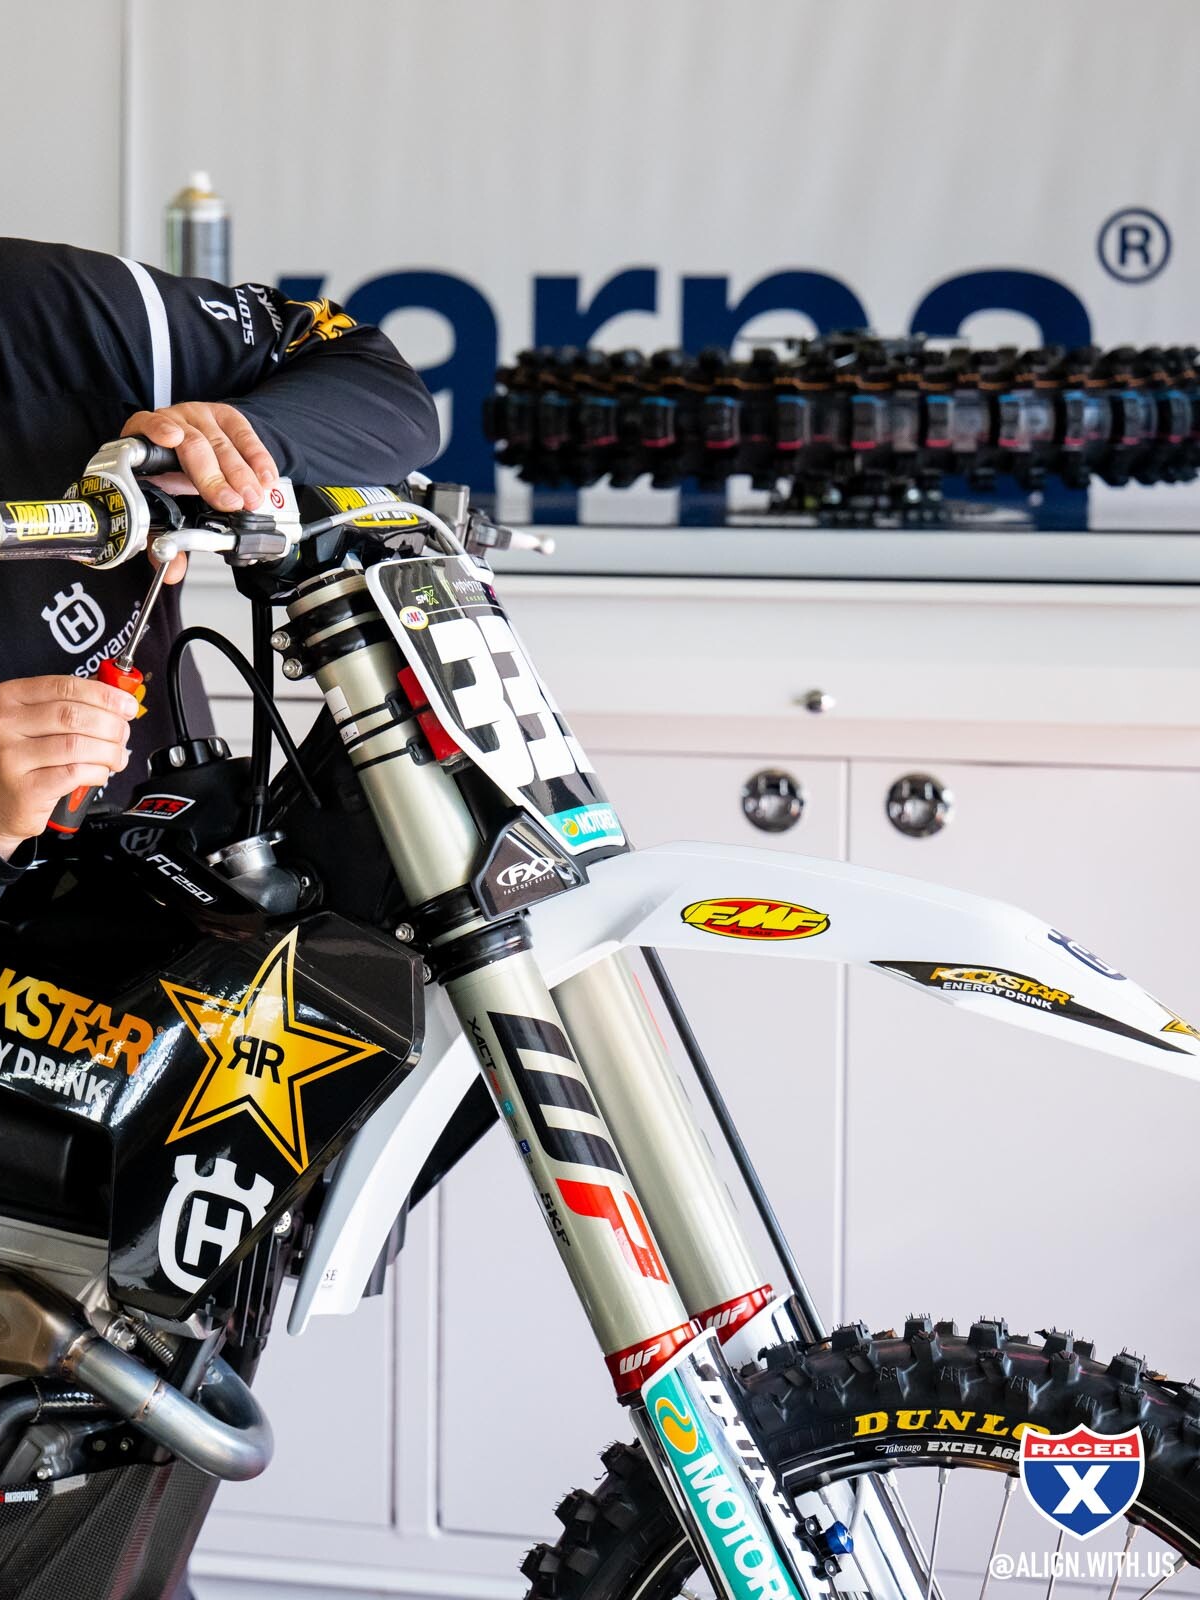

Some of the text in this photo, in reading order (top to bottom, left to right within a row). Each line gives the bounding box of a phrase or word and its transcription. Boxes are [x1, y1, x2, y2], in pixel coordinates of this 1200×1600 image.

[15, 503, 95, 536] PROTAPER
[682, 903, 830, 932] FMF
[930, 966, 1074, 1006] ROCKSTAR
[942, 981, 1053, 1011] ENERGY DRINK
[12, 1046, 112, 1105] DRINK
[540, 1192, 571, 1247] SKF
[926, 1440, 988, 1457] EXCEL
